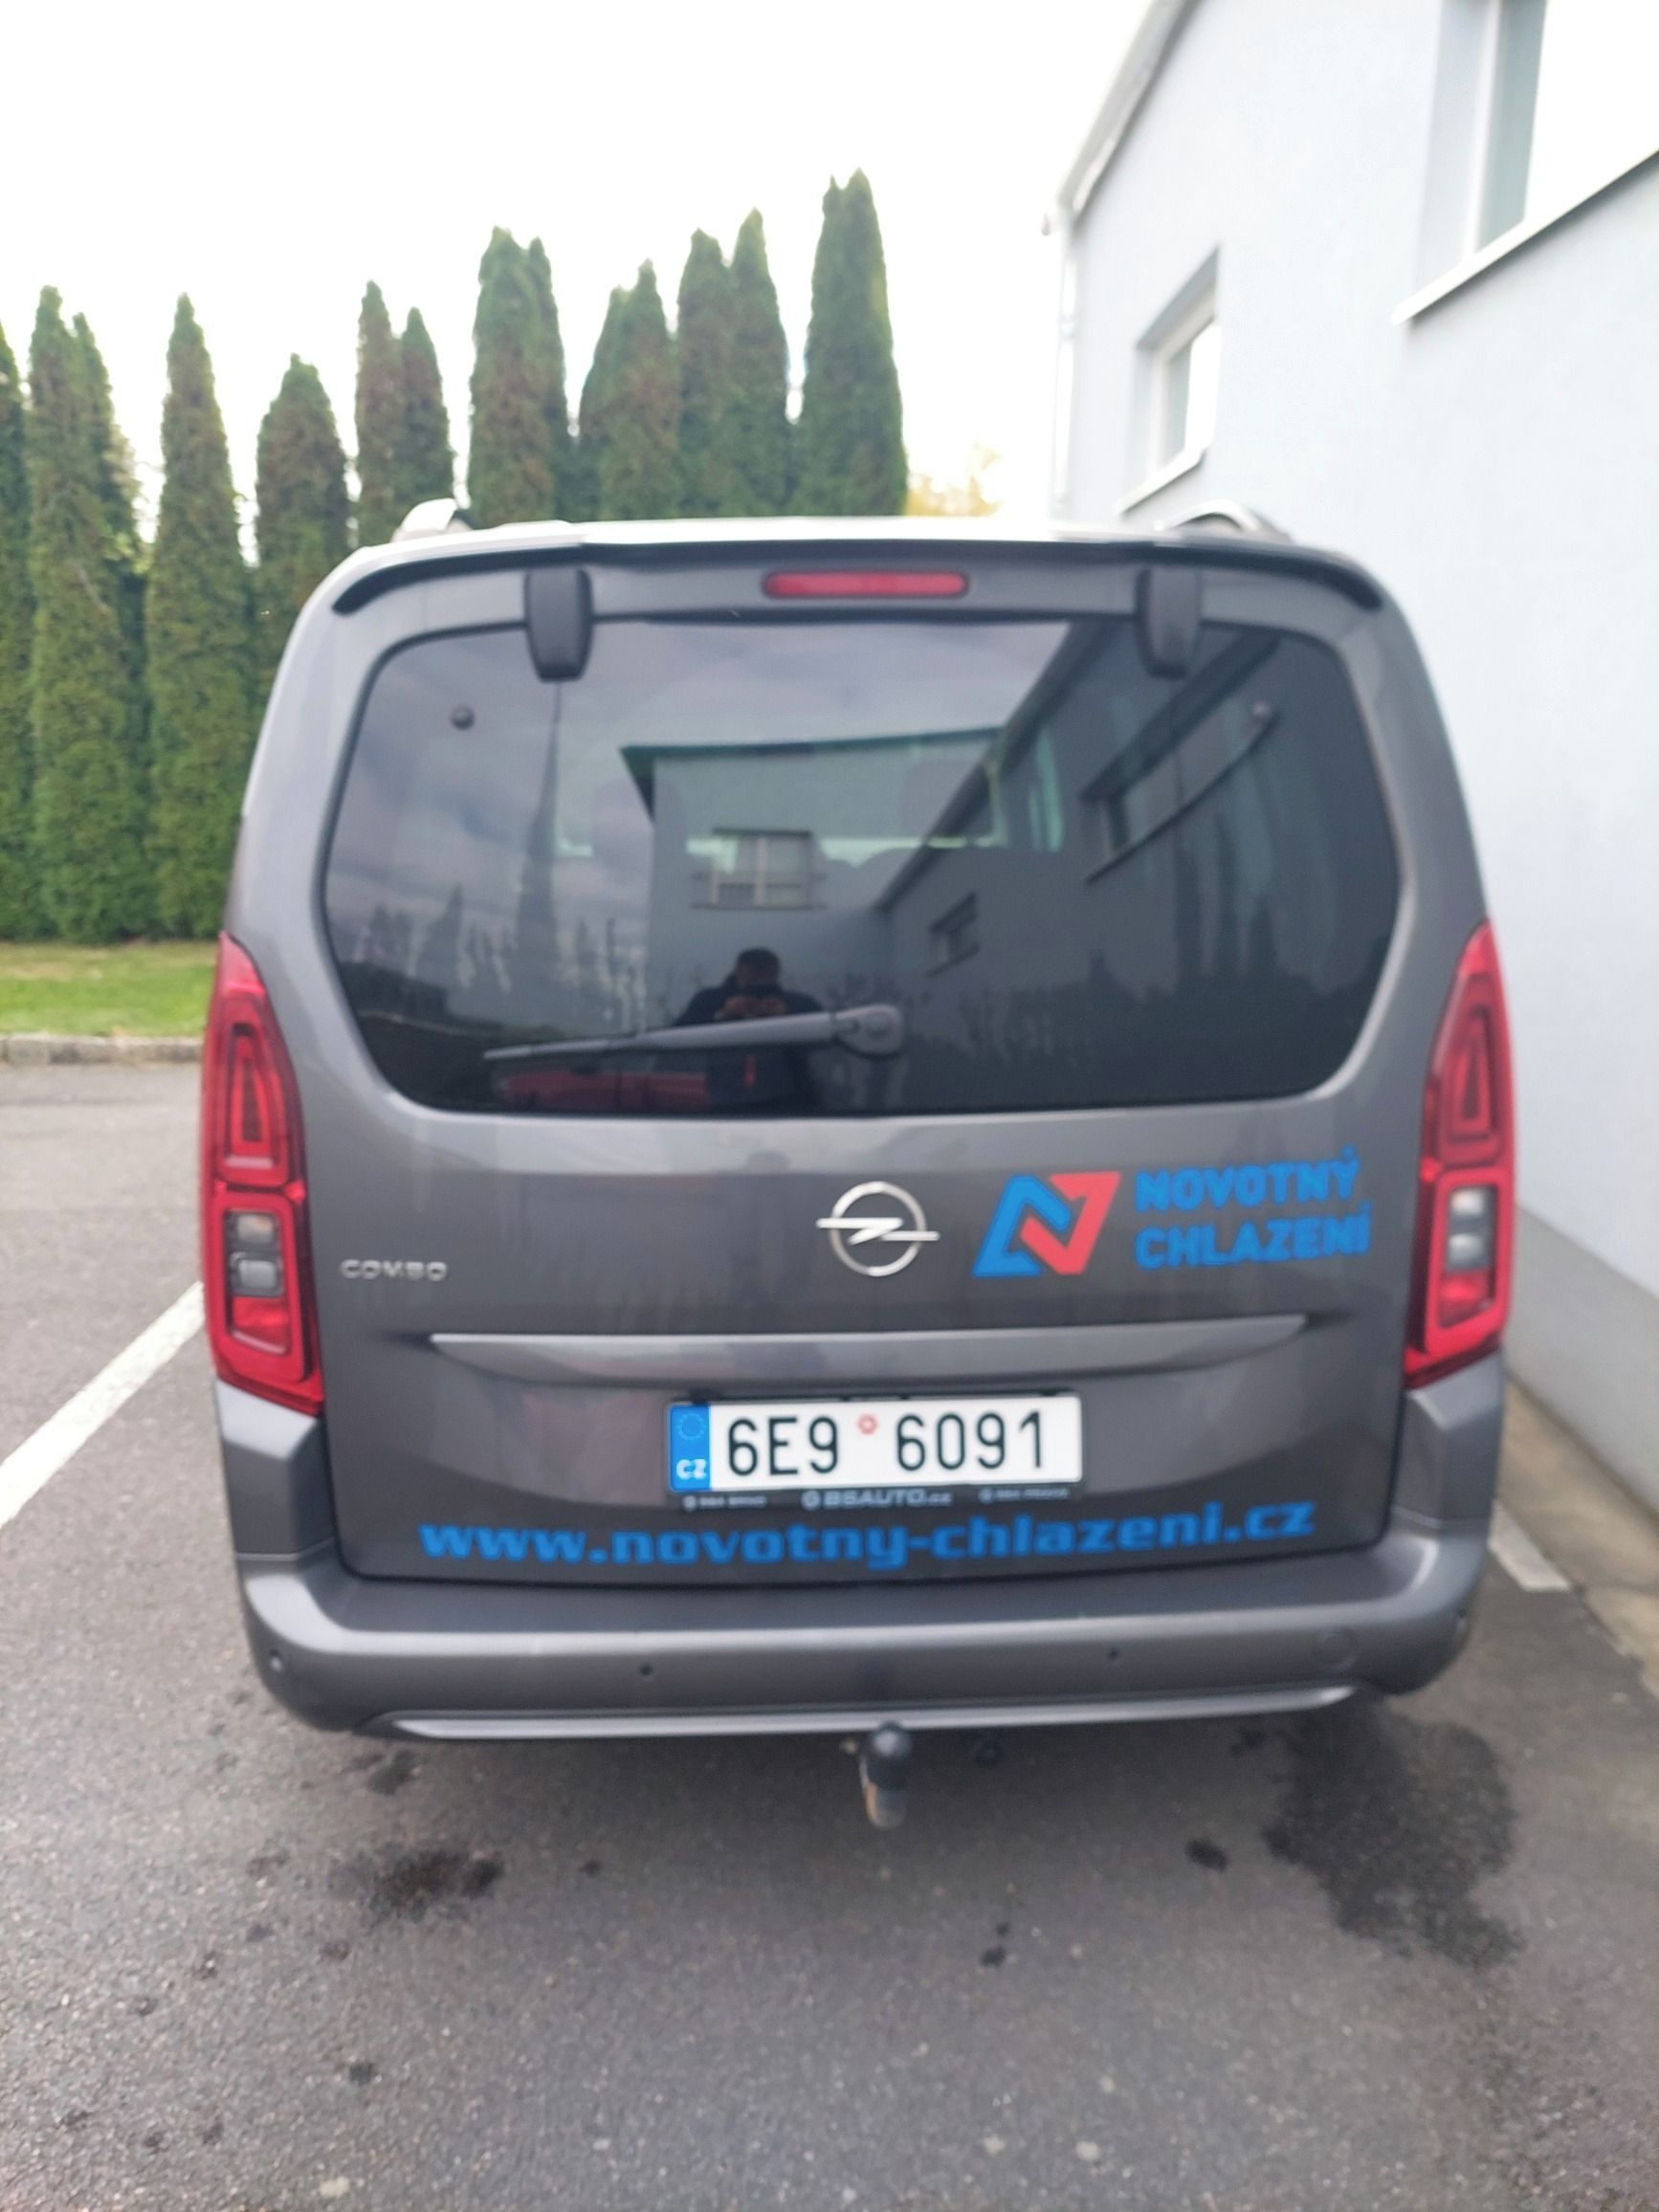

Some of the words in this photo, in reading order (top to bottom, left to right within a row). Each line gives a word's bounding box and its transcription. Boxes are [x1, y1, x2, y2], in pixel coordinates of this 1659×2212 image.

[1135, 1145, 1360, 1211] NOVOTNÝ
[1135, 1201, 1373, 1270] CHLAZENÍ
[727, 1416, 838, 1476] 6E9
[896, 1410, 1043, 1471] 6091
[418, 1500, 1315, 1571] www.novotny-chlazeni.cz
